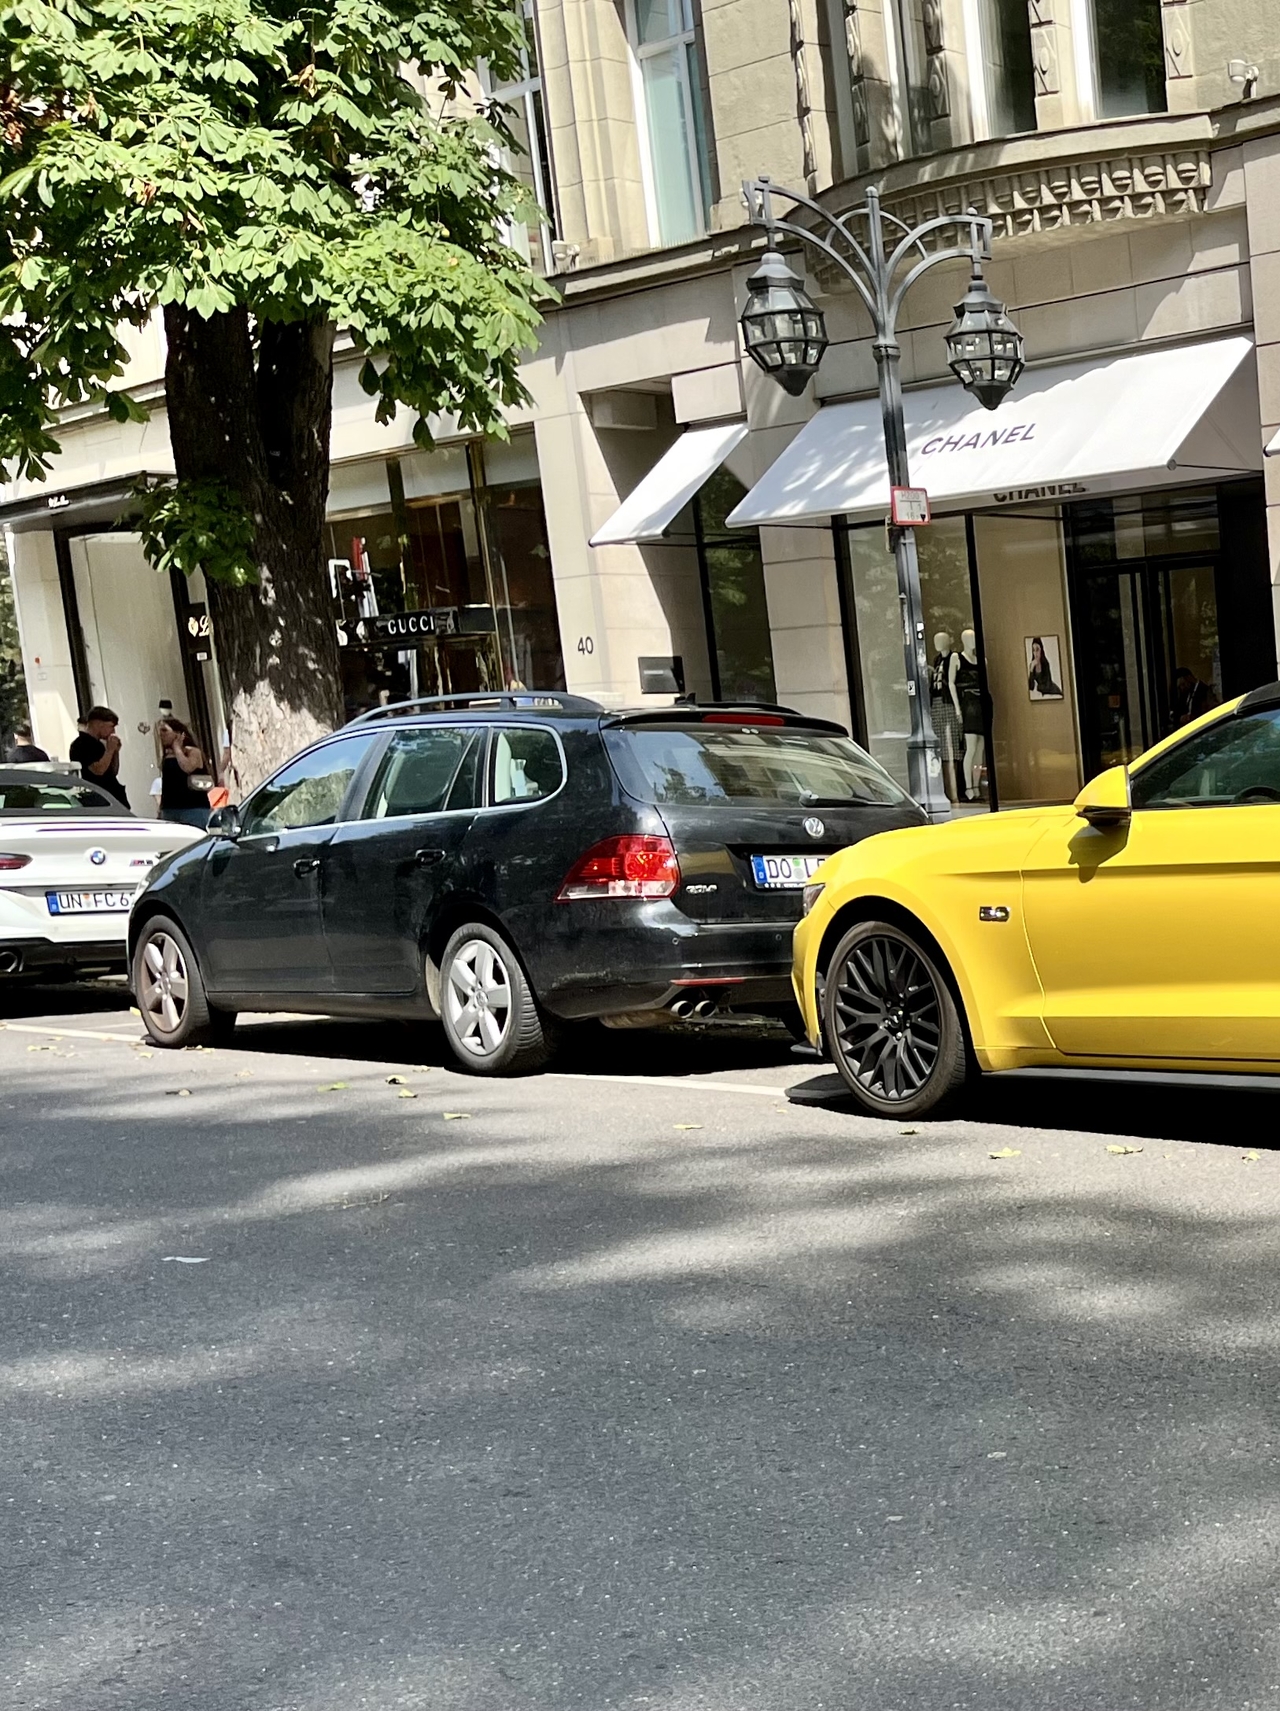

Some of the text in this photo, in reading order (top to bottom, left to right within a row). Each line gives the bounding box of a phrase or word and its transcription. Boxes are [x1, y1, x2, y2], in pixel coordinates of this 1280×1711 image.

[920, 423, 1036, 456] CHANEL
[387, 615, 435, 635] GUCCI
[577, 636, 594, 655] 40
[765, 858, 792, 879] DO
[58, 892, 83, 909] UN
[93, 891, 116, 908] FC
